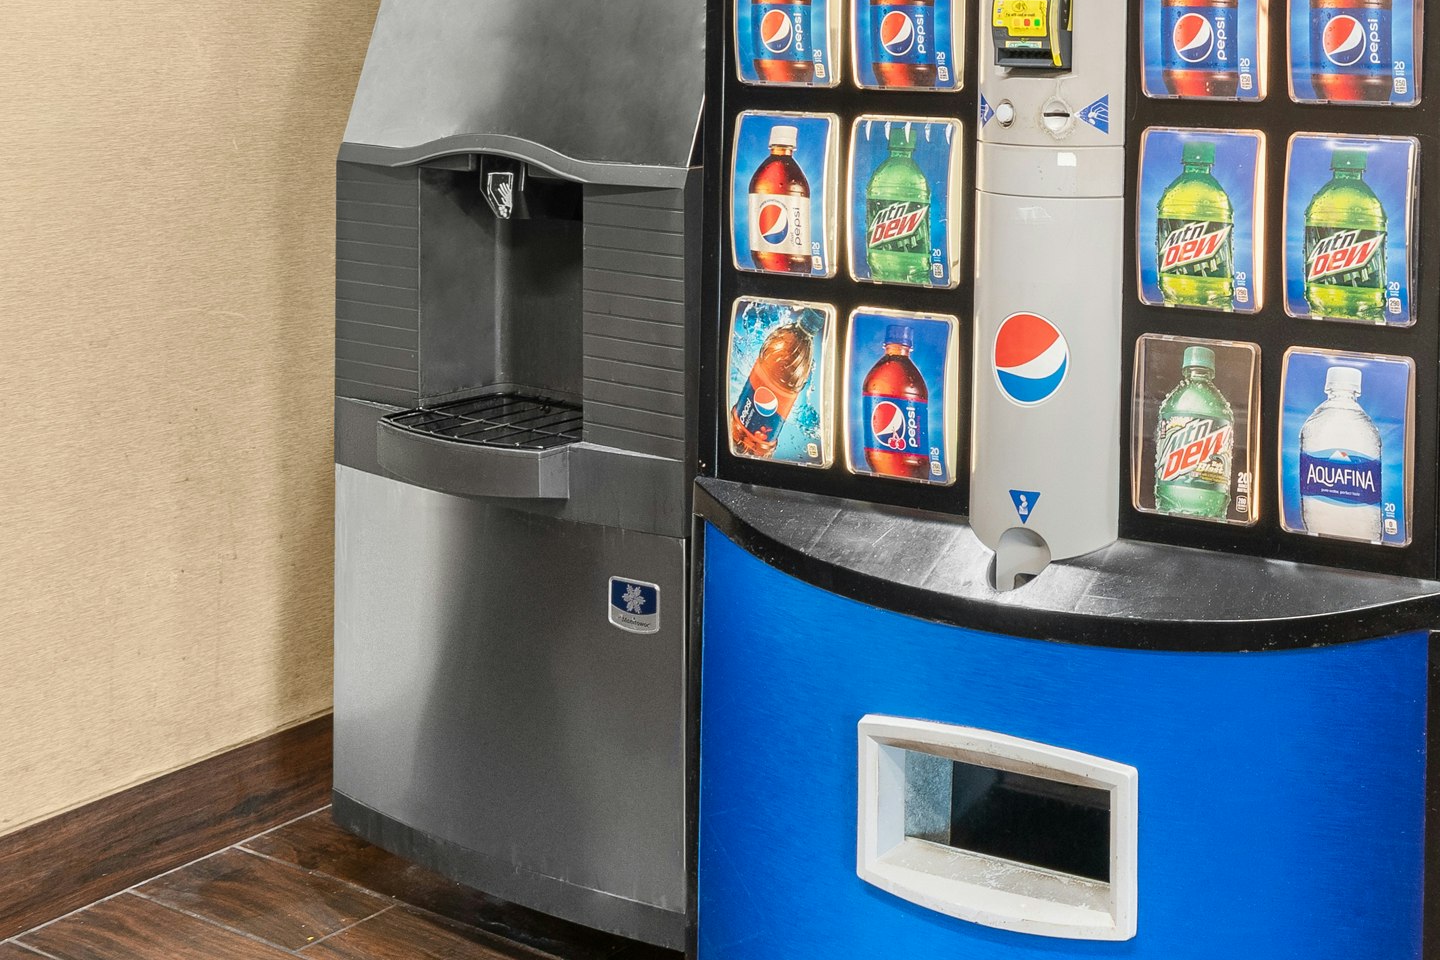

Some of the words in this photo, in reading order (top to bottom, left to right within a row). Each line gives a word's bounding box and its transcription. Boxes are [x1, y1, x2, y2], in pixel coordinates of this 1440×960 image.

[915, 14, 927, 54] pepsi
[1215, 16, 1228, 61] pepsi
[1367, 18, 1381, 64] pepsi
[1239, 58, 1250, 67] 20
[794, 206, 802, 247] pepsi
[1235, 271, 1246, 281] 20
[906, 406, 918, 448] pepsi
[1307, 463, 1376, 493] AQUAFINA
[1384, 503, 1395, 512] 20
